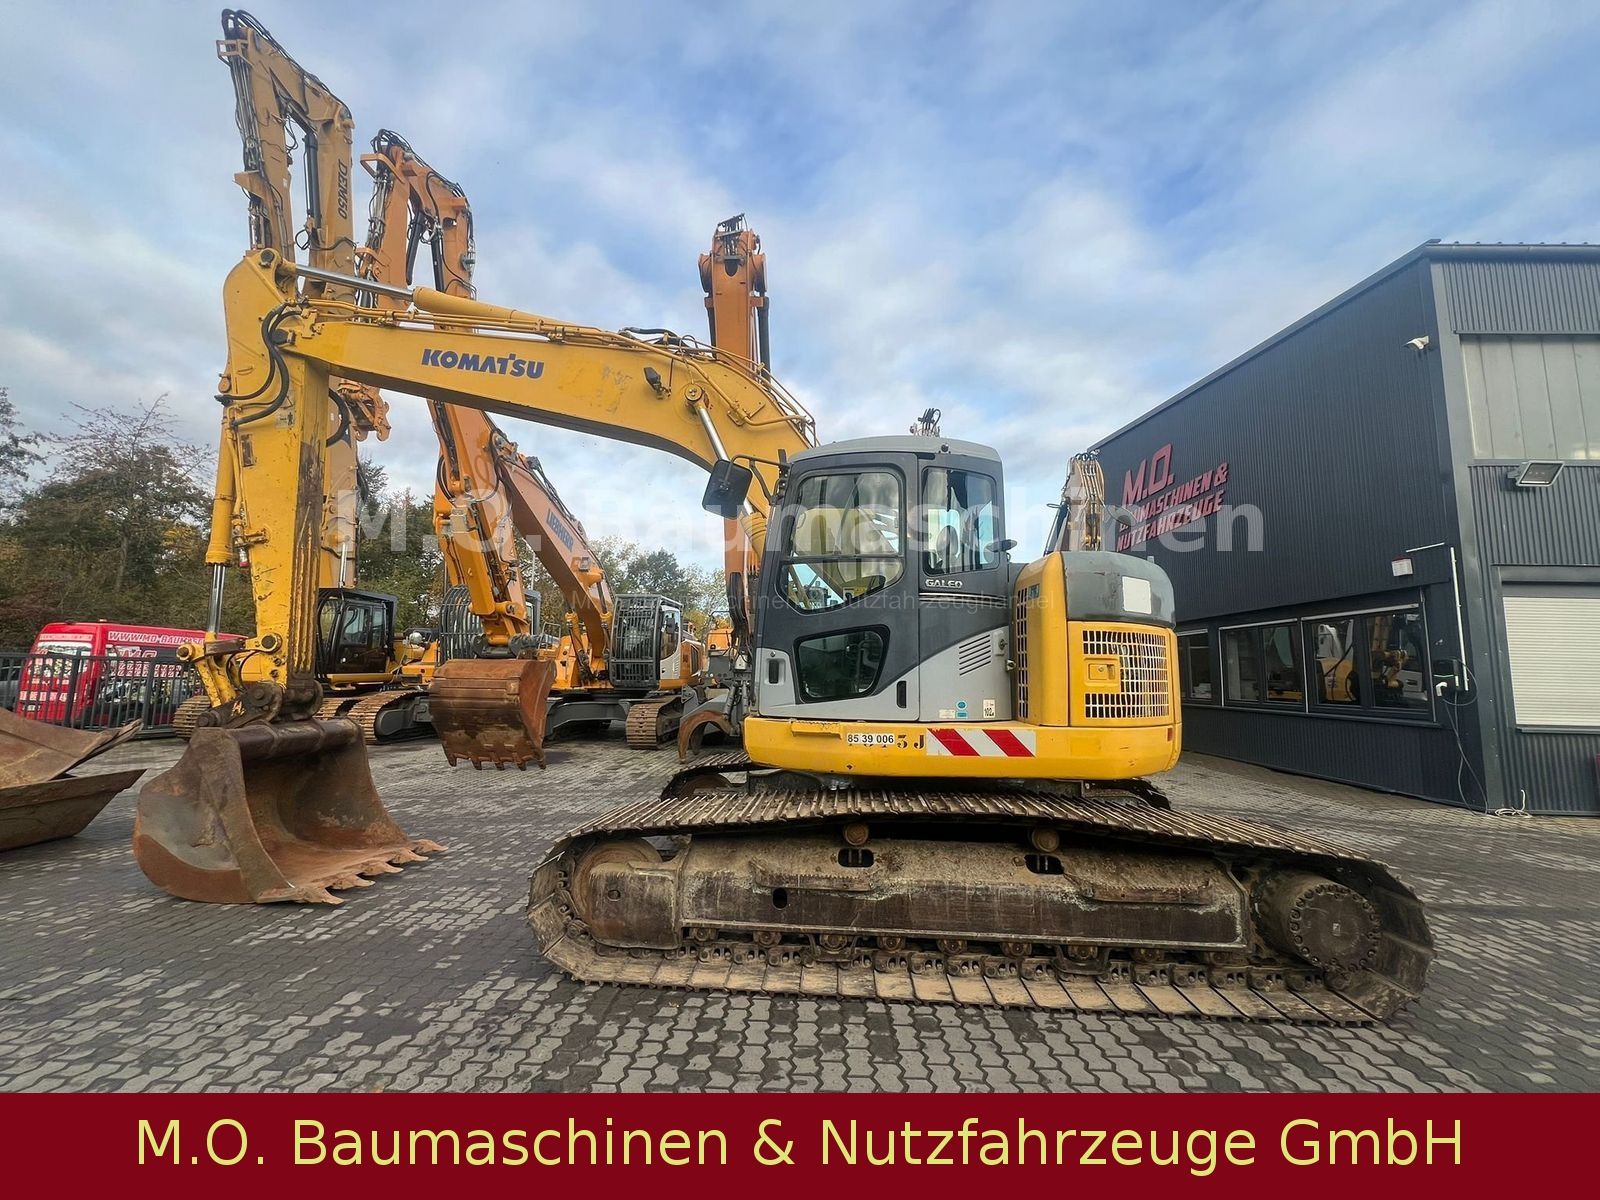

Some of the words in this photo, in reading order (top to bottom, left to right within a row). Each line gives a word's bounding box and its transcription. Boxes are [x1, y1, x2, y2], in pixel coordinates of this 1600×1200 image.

[338, 158, 348, 220] DEM50
[421, 348, 545, 379] KOMATSU
[1122, 443, 1174, 509] M.O.
[1213, 462, 1228, 487] &
[1116, 490, 1225, 553] NUTZFAHRZEUGE
[925, 579, 963, 589] GALEO
[847, 734, 859, 743] 85
[861, 734, 873, 743] 39
[876, 734, 894, 743] 006
